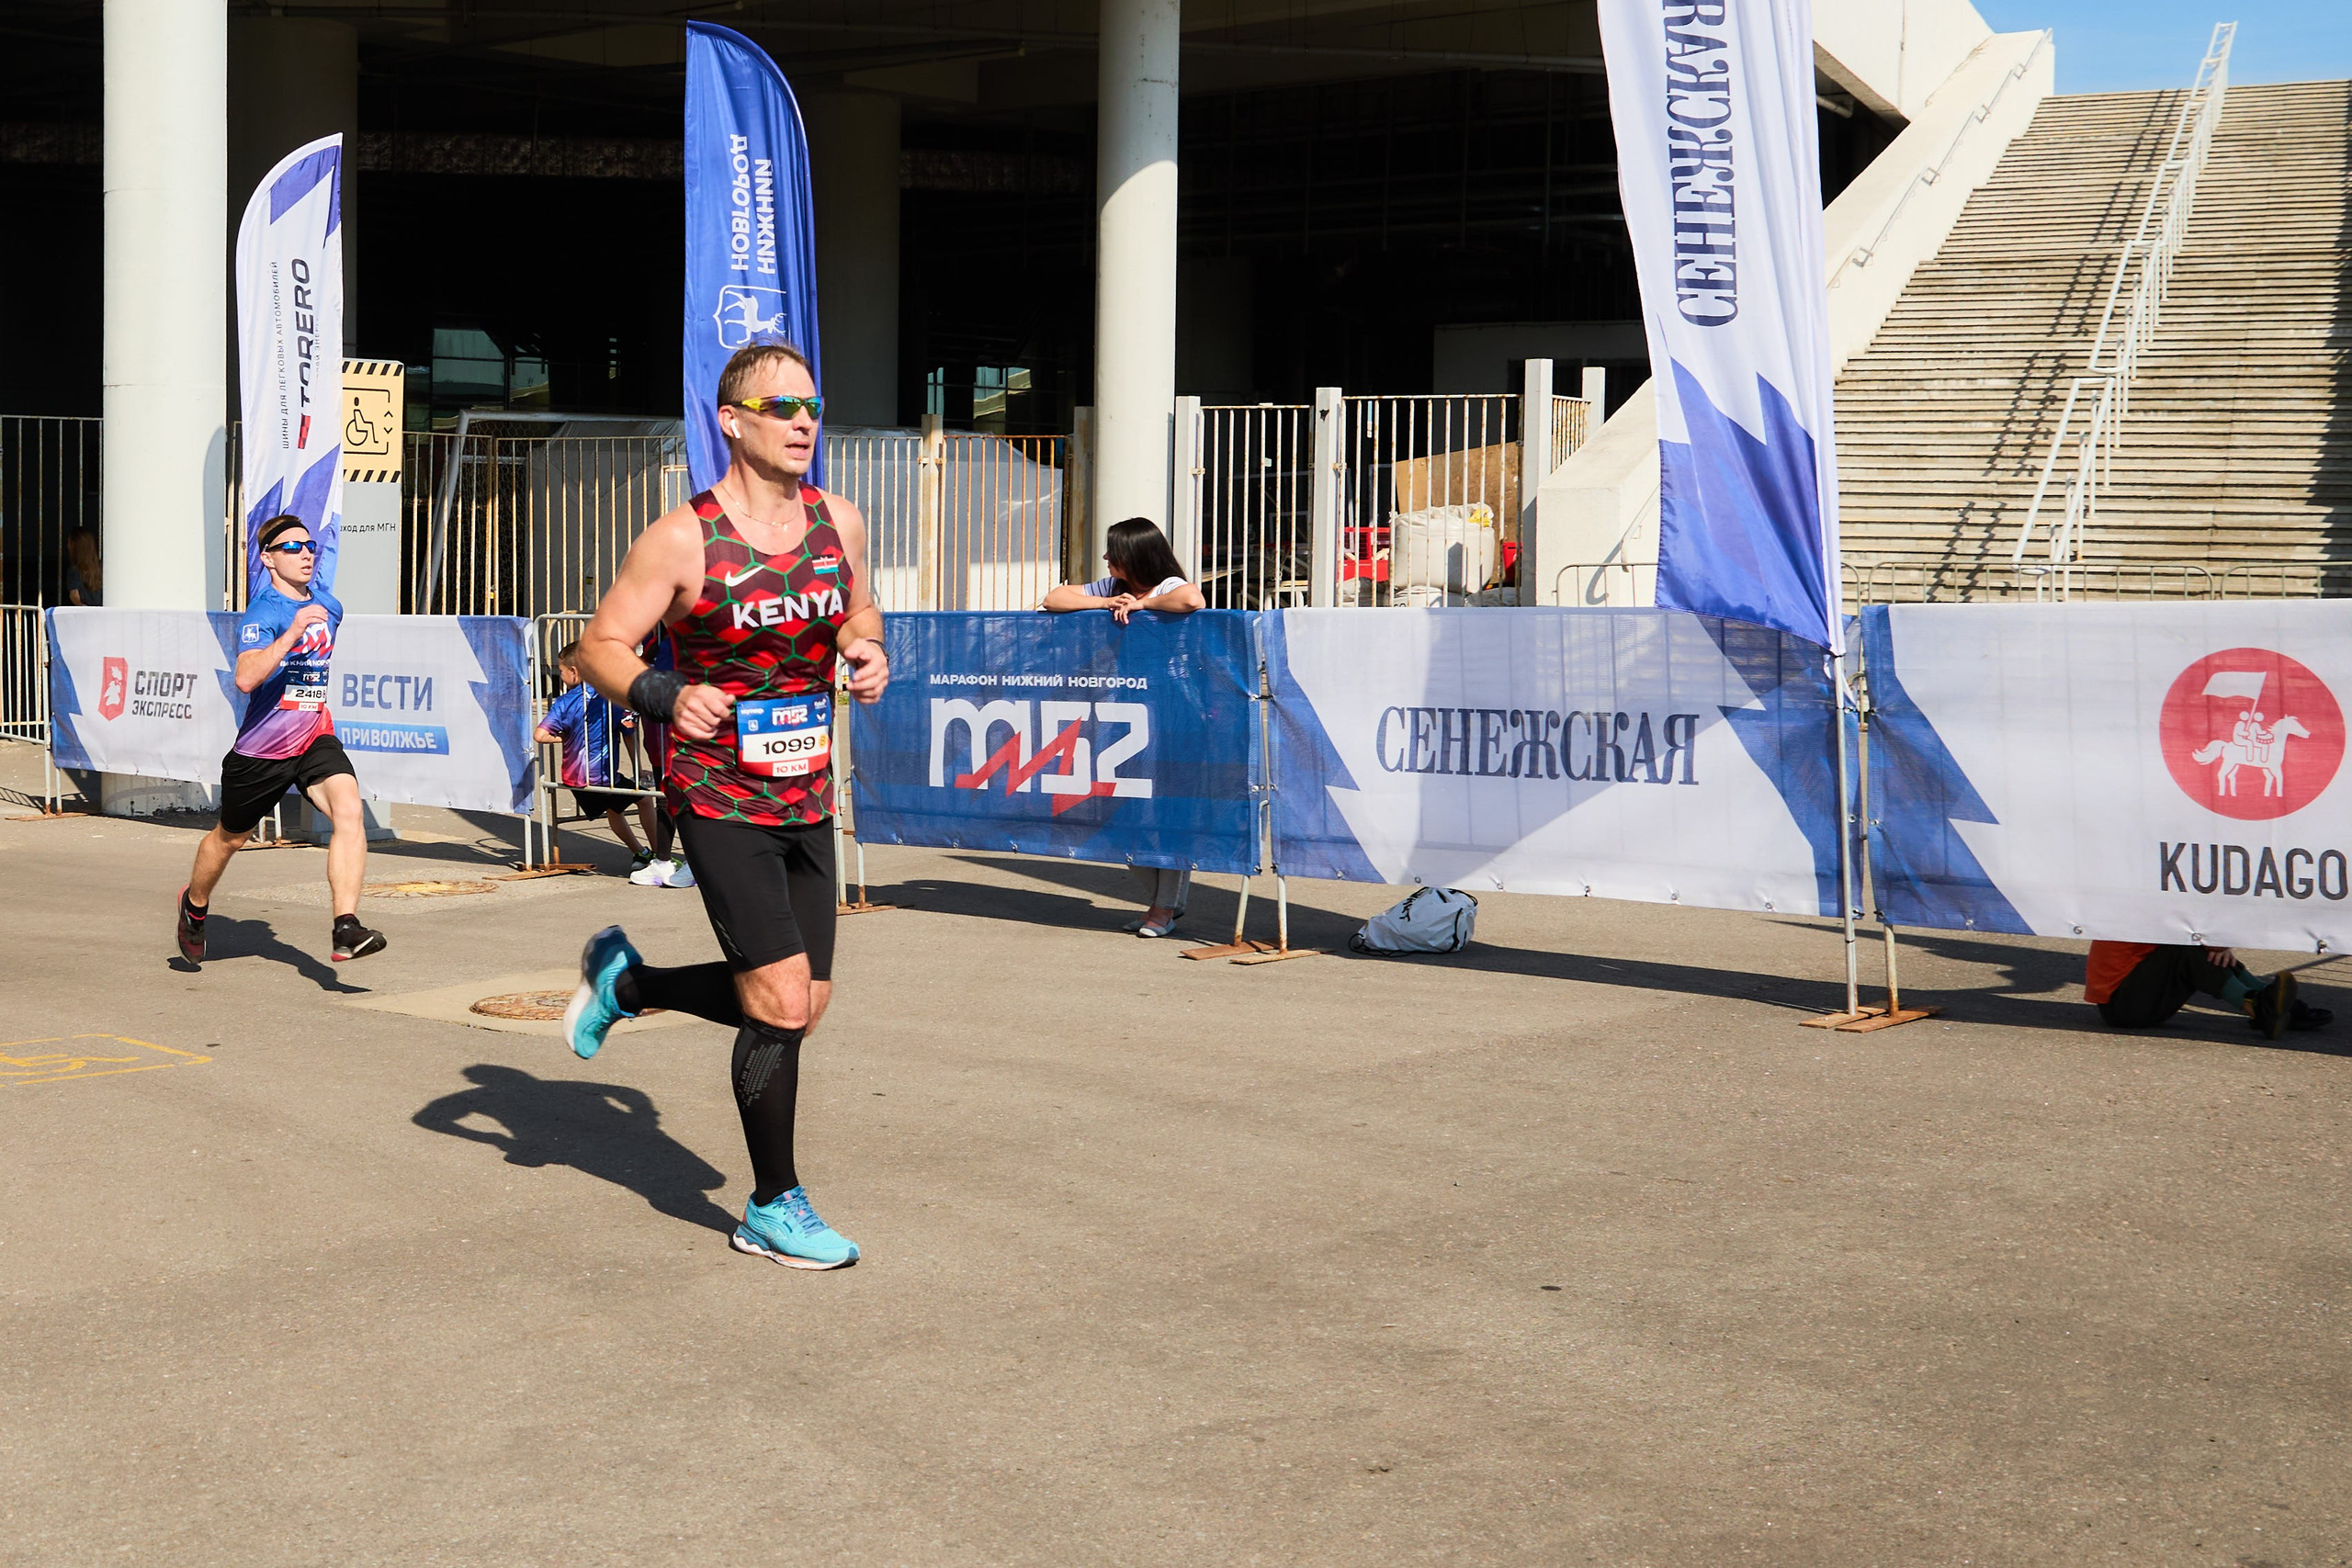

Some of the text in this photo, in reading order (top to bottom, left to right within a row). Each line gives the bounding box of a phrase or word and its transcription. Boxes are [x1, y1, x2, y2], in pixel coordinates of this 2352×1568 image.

[271, 261, 283, 335] АВТОМОБИЛЕЙ
[291, 258, 314, 408] TORERO
[277, 336, 287, 392] ЛЕГКОВЫХ
[359, 525, 375, 533] для
[377, 523, 396, 532] МГН
[732, 589, 843, 629] KENYA
[134, 671, 198, 699] СПОРТ
[295, 689, 322, 698] 2418
[342, 673, 433, 711] ВЕСТИ
[930, 674, 1148, 690] МАРАФОН НИЖНИЙ НОВГОРОД
[131, 699, 193, 719] ЭКСПРЕСС
[341, 727, 437, 749] ПРИВОЛЖЬЕ
[762, 736, 816, 755] 1099
[1375, 705, 1700, 785] СЕНЕЖСКАЯ
[776, 762, 807, 773] 10 KM
[2159, 841, 2349, 901] KUDAGO
